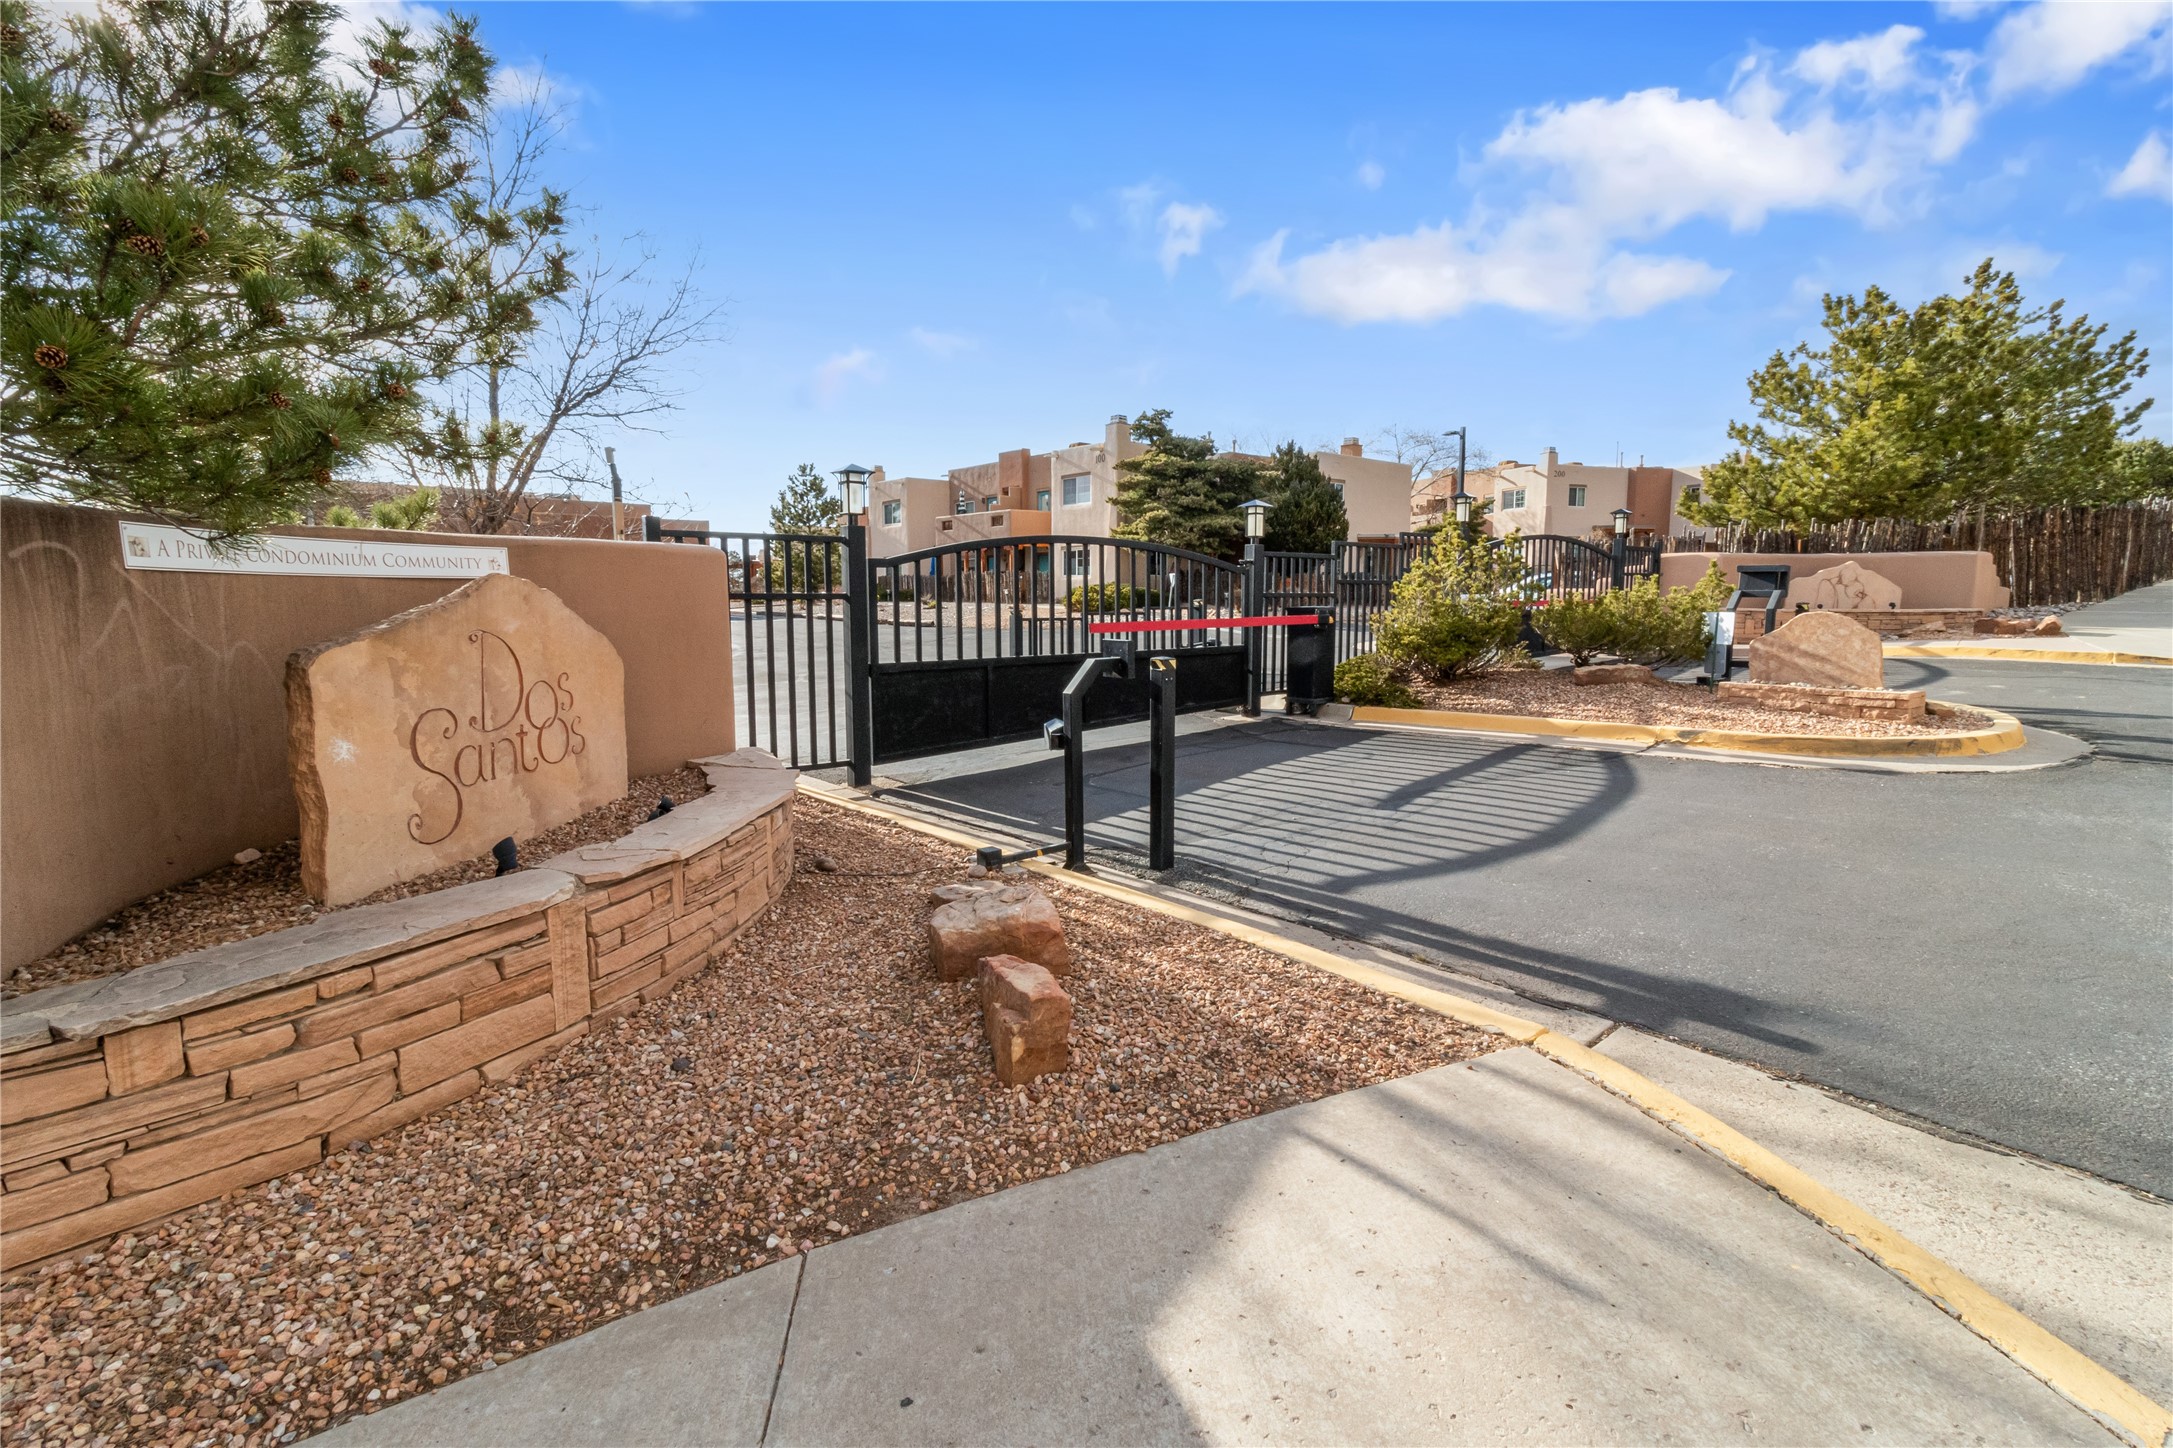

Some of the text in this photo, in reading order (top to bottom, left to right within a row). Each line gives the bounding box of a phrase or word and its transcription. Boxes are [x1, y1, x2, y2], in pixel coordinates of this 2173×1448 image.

[1095, 453, 1106, 464] 100
[1553, 470, 1566, 478] 200
[158, 539, 170, 557] A
[246, 546, 377, 567] CONDOMINIUM
[382, 553, 481, 569] COMMUNITY
[468, 629, 574, 733] Dos
[407, 707, 586, 845] Santos
